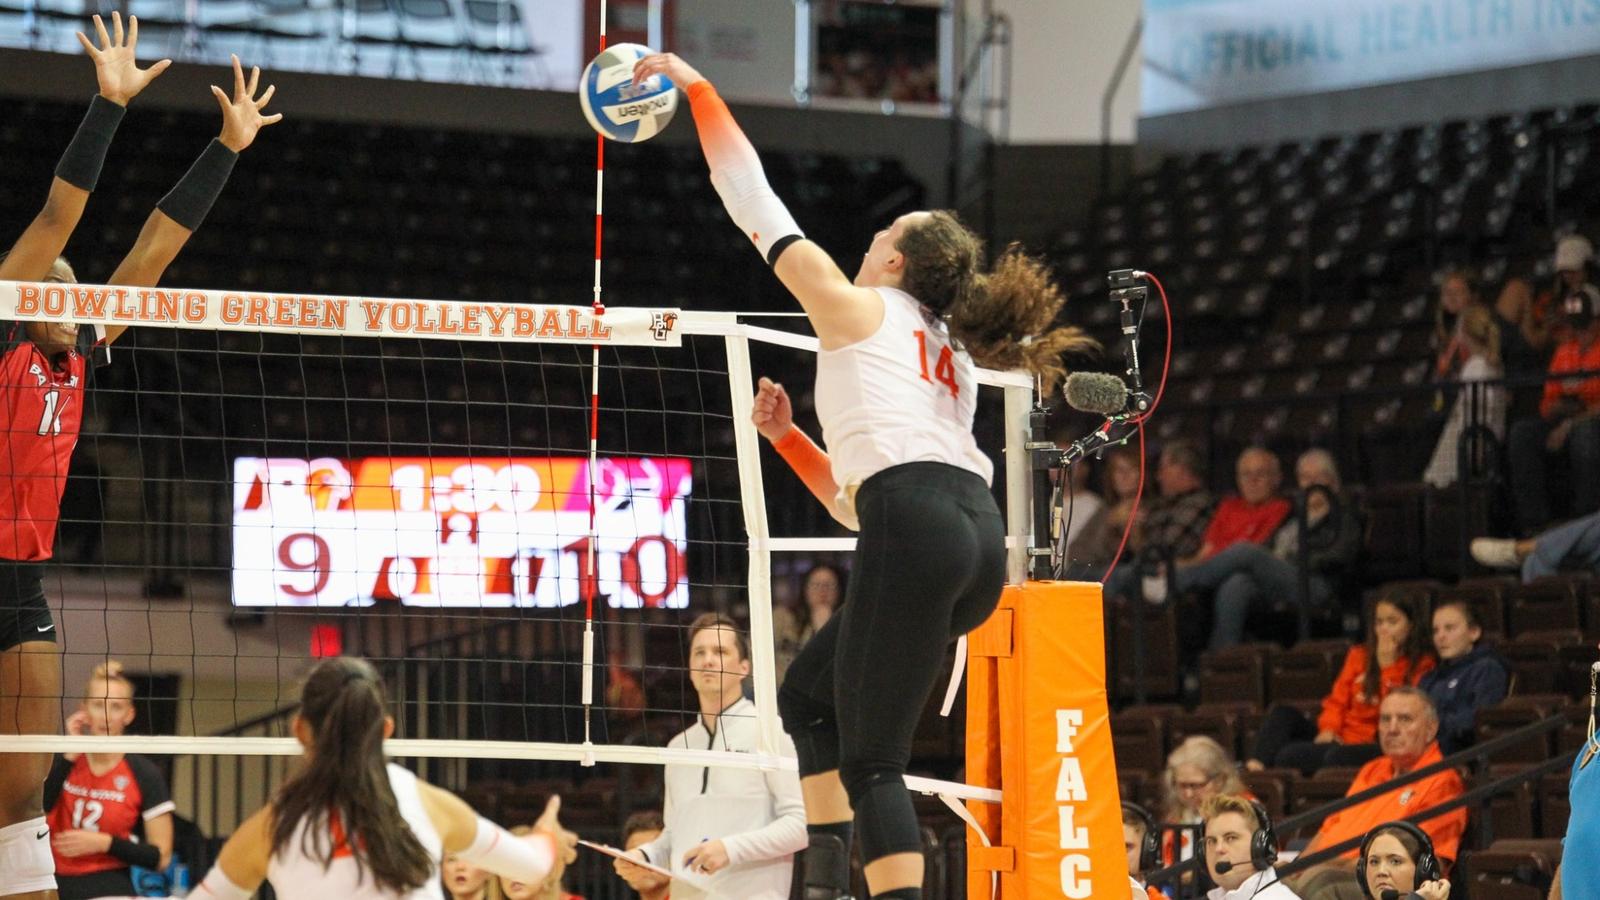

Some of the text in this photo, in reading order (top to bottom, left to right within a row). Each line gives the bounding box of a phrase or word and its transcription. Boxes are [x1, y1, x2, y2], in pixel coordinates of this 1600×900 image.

[1173, 18, 1343, 81] OFFICIAL
[1359, 0, 1513, 54] HEALTH
[618, 95, 670, 118] molten
[16, 285, 612, 340] BOWLING GREEN VOLLEYBALL
[913, 330, 960, 400] 14
[278, 532, 331, 597] 9
[563, 534, 687, 607] 10
[72, 799, 104, 833] 12
[1055, 708, 1093, 900] FALC
